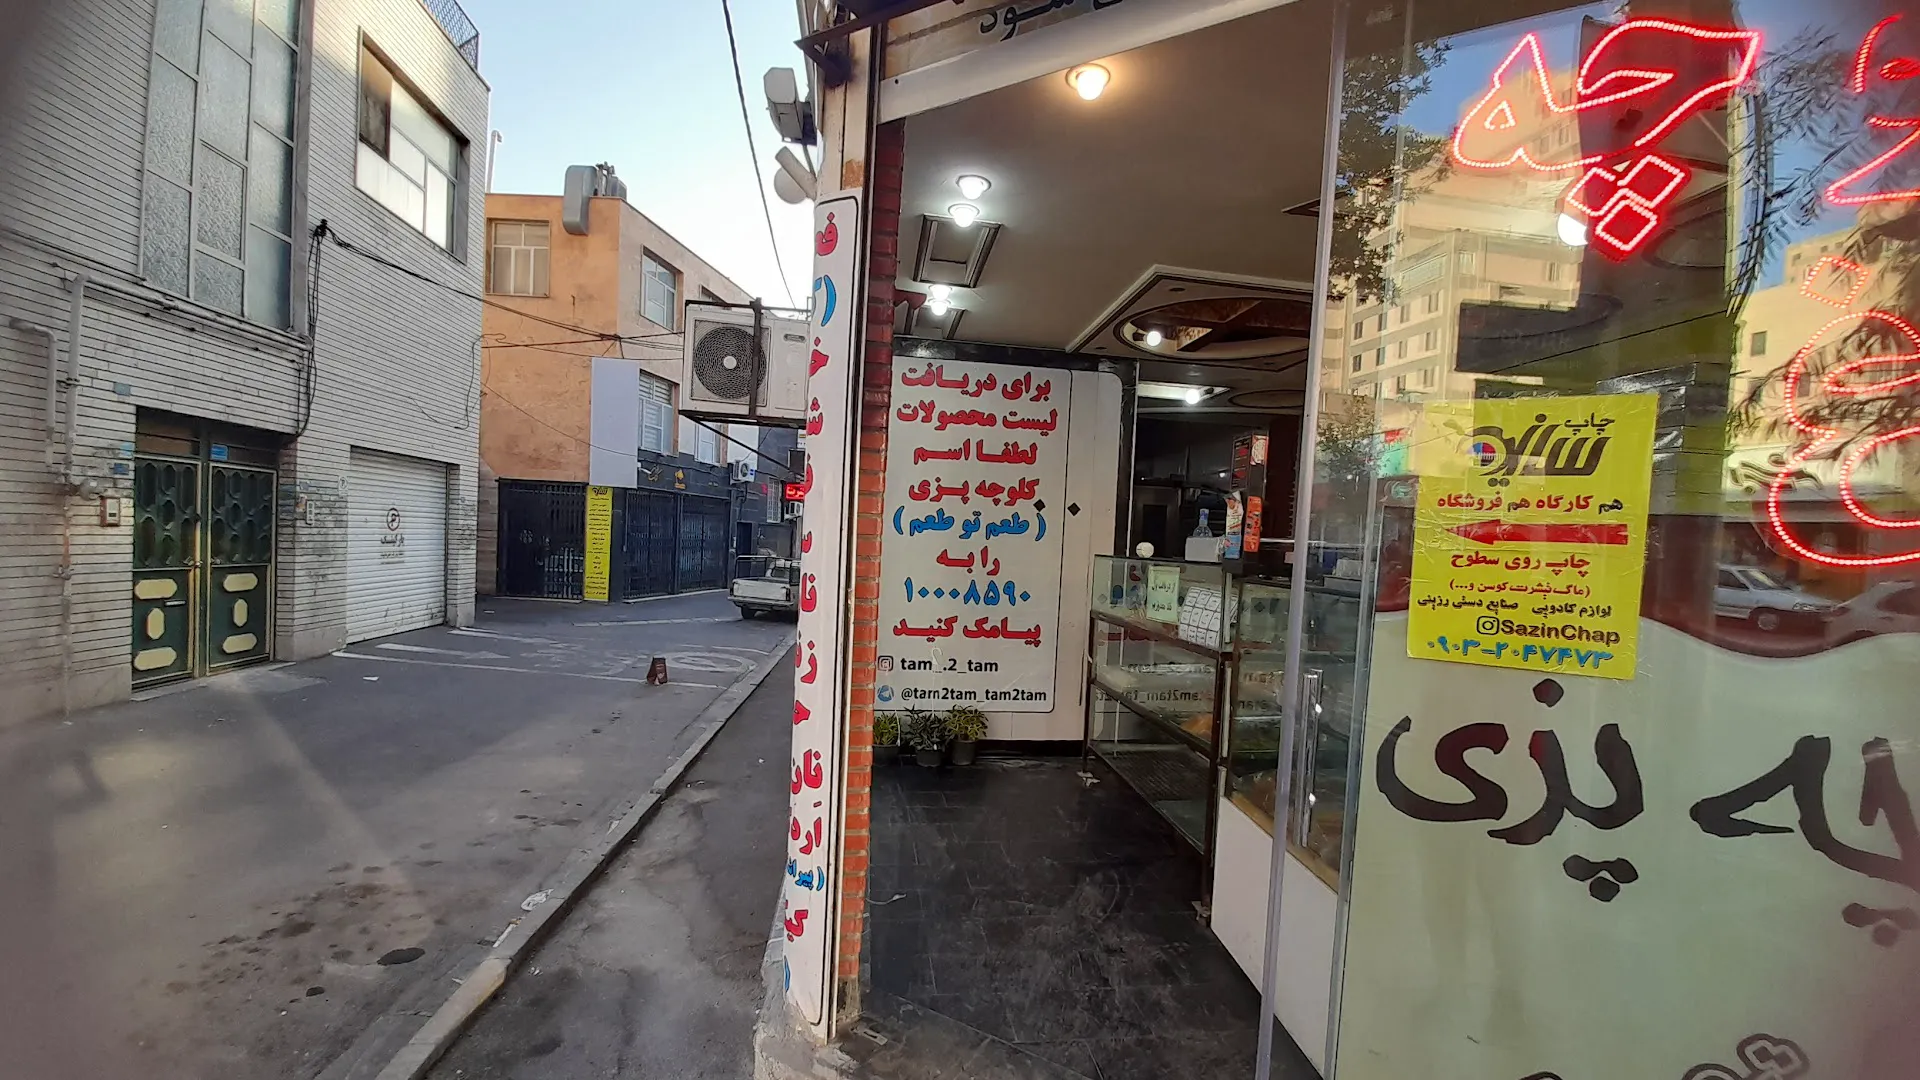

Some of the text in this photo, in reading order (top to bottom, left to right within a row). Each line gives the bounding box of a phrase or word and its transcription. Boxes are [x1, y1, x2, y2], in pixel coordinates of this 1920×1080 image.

[901, 363, 1051, 401] برای دریافت
[897, 400, 1058, 436] لیست محصولات
[1564, 412, 1616, 435] چاپ
[914, 438, 1038, 465] لطفا اسم
[908, 477, 1040, 507] کلوچه پزی
[1437, 491, 1624, 514] هم کارگاه هم فروشگاه
[893, 506, 1047, 541] (طعم تو طعم)
[936, 546, 1001, 576] را به
[1451, 551, 1591, 577] چاپ روی سطوح
[904, 577, 1031, 606] ۱۰۰۰۸۵۹۰
[1478, 581, 1509, 593] کوسن
[1417, 595, 1611, 619] لوازم کادویی صنایع دستی رزینی
[893, 615, 1042, 647] پیامک کنید
[1500, 619, 1620, 647] SazinChap
[1376, 678, 1644, 903] پزی
